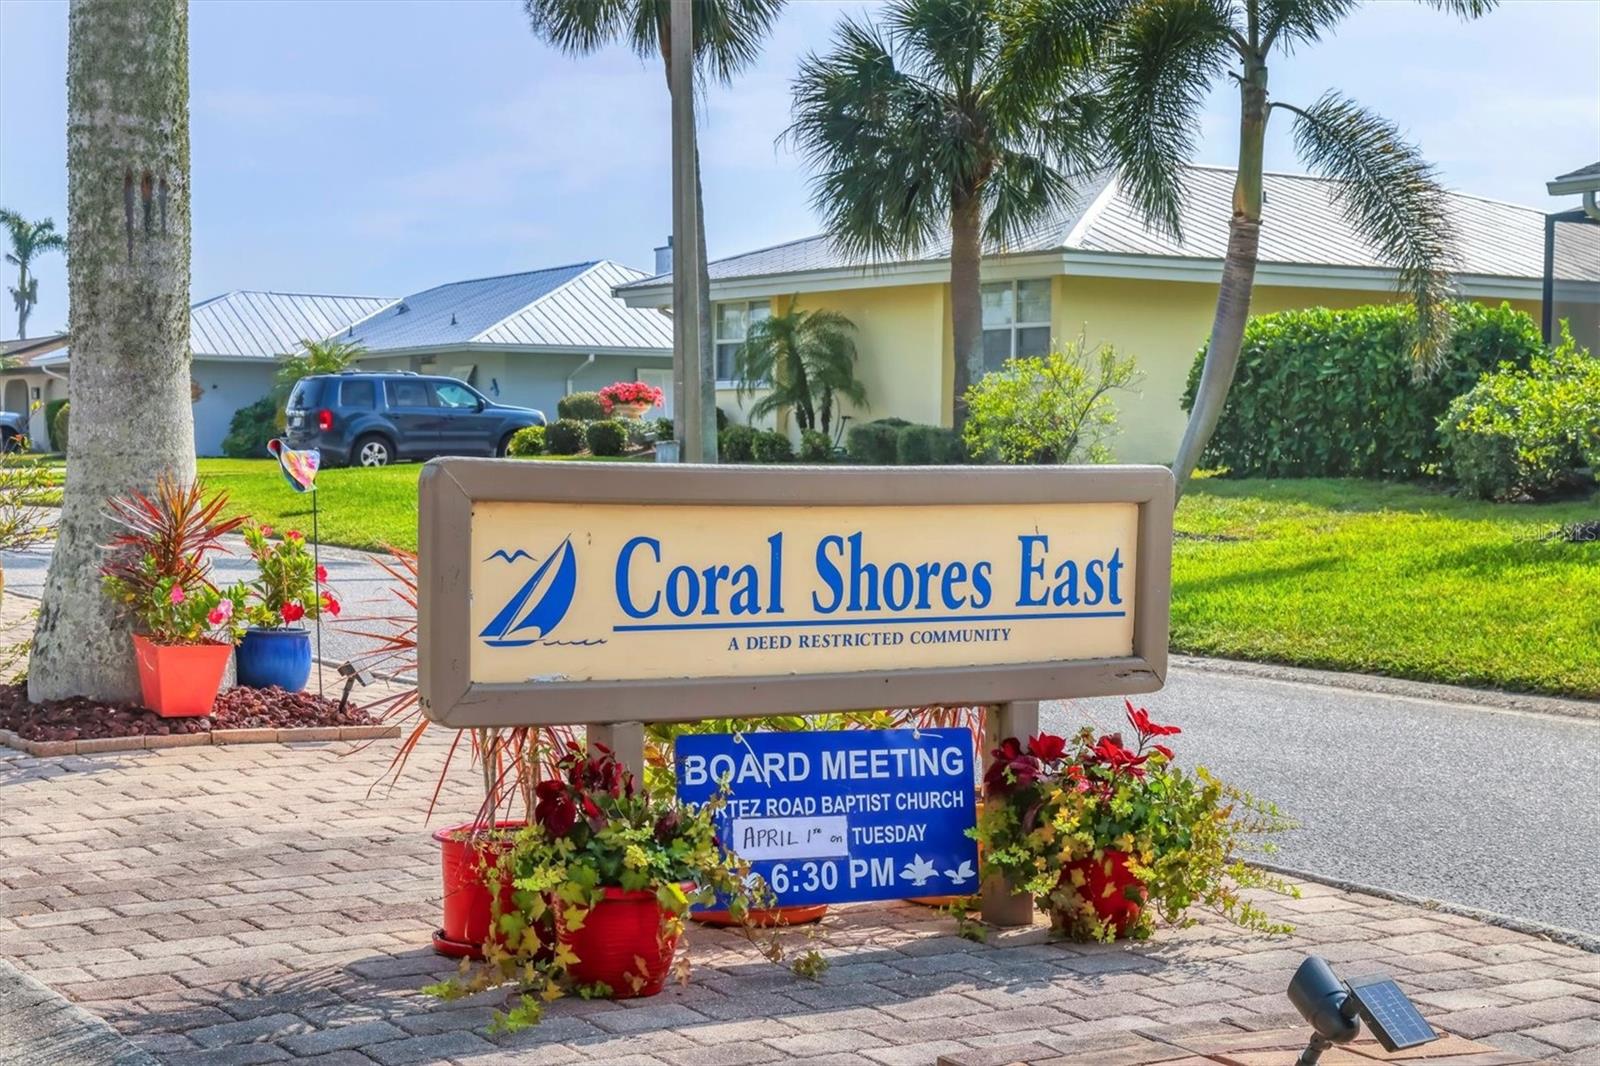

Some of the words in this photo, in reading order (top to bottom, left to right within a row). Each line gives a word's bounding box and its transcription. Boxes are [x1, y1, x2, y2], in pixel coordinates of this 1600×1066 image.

[615, 531, 785, 619] Coral
[811, 531, 992, 615] Shores
[1016, 534, 1124, 608] East
[728, 636, 740, 651] A
[746, 635, 792, 650] DEED
[798, 631, 904, 649] RESTRICTED
[909, 628, 1011, 645] COMMUNITY
[685, 751, 810, 786] BOARD
[821, 746, 964, 781] MEETING
[766, 796, 816, 817] ROAD
[821, 793, 891, 814] BAPTIST
[895, 790, 964, 811] CHURCH
[743, 826, 799, 850] APRIL
[829, 835, 843, 843] on
[852, 824, 927, 845] TUESDAY
[771, 861, 838, 893] 6:30
[849, 856, 895, 889] PM
